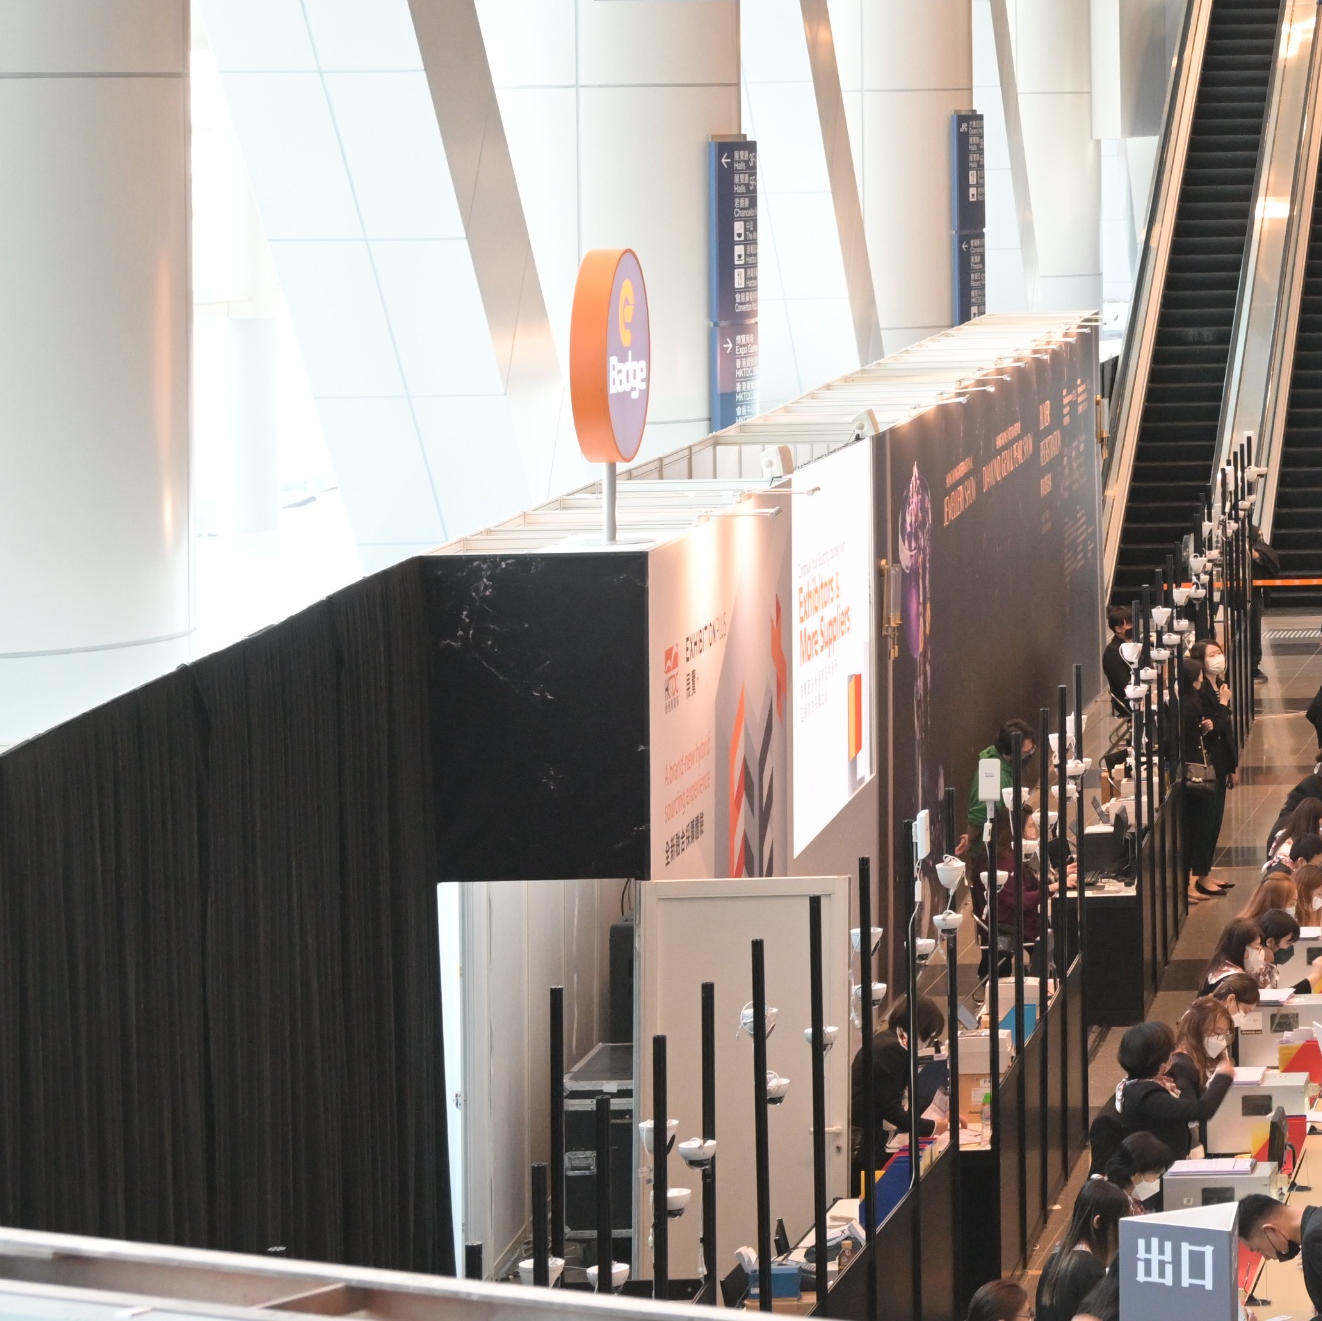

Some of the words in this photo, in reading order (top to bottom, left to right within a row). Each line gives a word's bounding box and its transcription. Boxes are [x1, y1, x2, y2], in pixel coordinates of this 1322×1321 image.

[609, 349, 647, 399] Badge
[799, 572, 834, 624] Exhibitors
[800, 627, 818, 667] More
[820, 605, 851, 657] Suppliers
[1136, 1237, 1214, 1290] 出口
